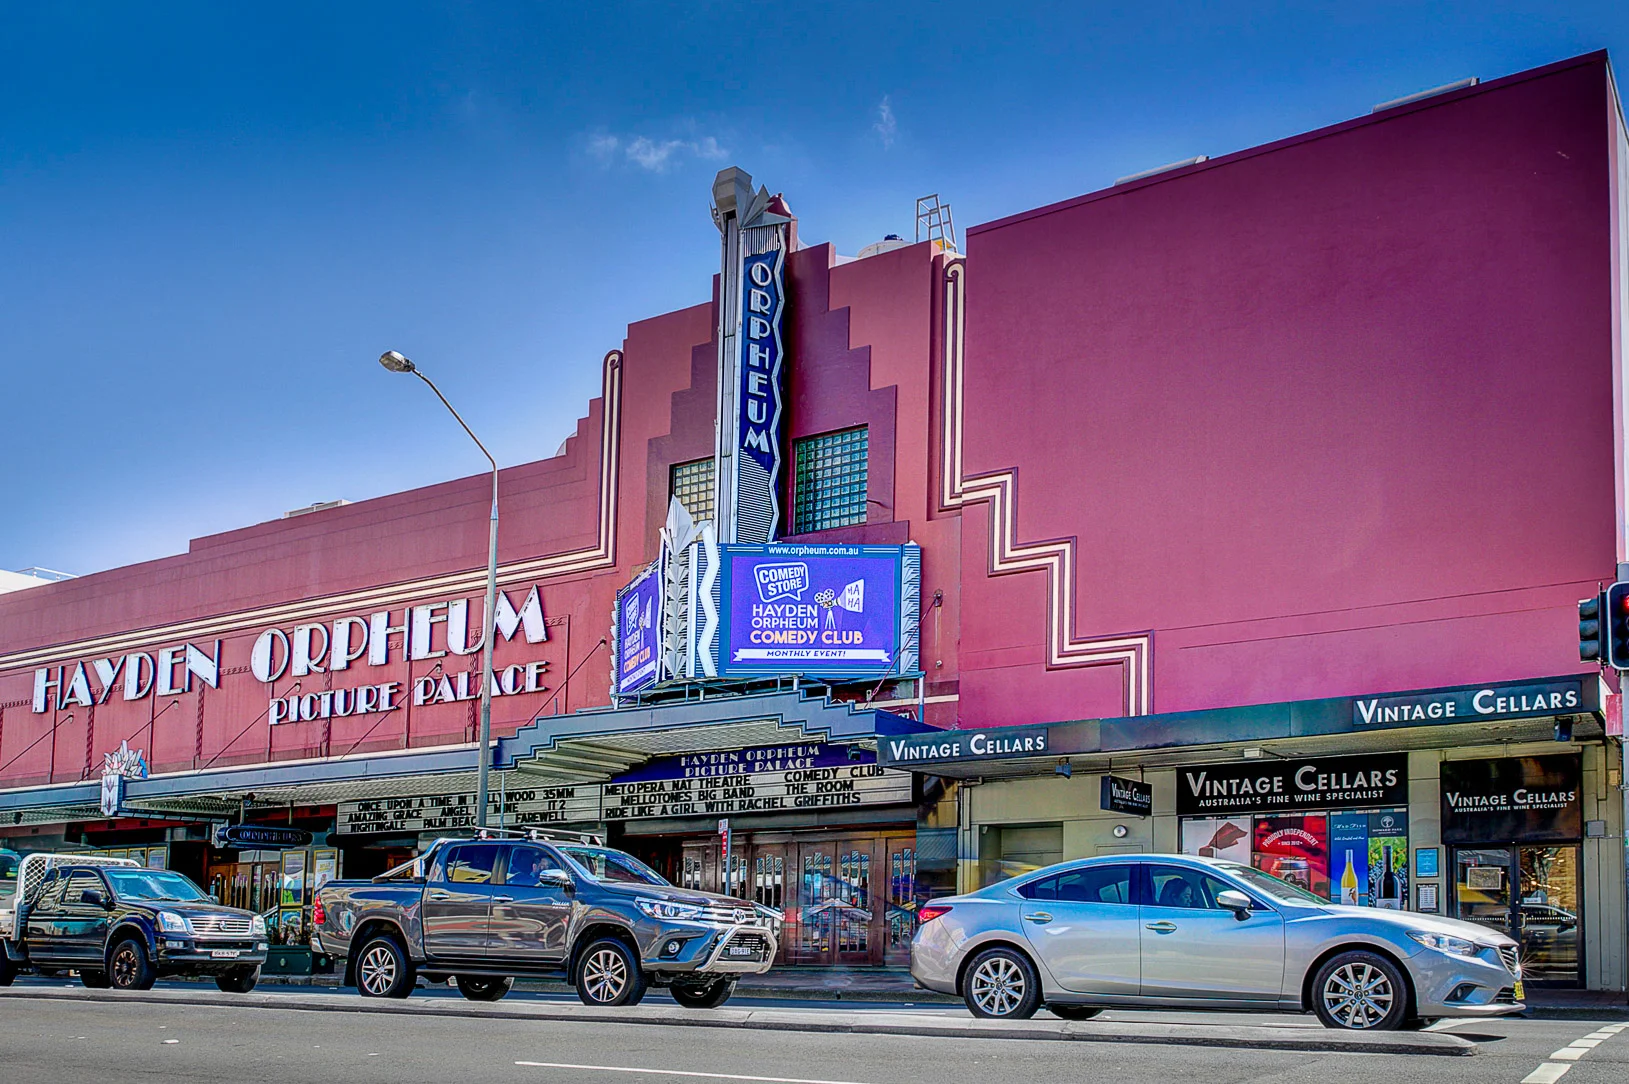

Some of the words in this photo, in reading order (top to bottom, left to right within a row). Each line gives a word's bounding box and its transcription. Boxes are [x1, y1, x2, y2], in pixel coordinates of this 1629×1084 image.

[744, 262, 772, 453] ORPHEUM
[768, 546, 859, 556] www.orpheum.com.au
[759, 566, 805, 584] COMEDY
[768, 579, 802, 596] STORE
[752, 604, 818, 617] HAYDEN
[751, 617, 819, 629] ORPHEUM
[750, 630, 818, 644] COMEDY
[821, 630, 864, 644] CLUB
[32, 638, 221, 714] HAYDEN
[250, 584, 548, 683] ORPHEUM
[269, 681, 400, 726] PICTURE
[413, 660, 549, 707] PALACE
[1356, 698, 1456, 725] VINTAGE
[1472, 689, 1578, 714] CELLARS
[681, 752, 739, 767] HAYDEN
[746, 745, 820, 760] ORPHEUM
[890, 740, 960, 761] VINTAGE
[970, 734, 1045, 755] CELLARS
[671, 779, 694, 791] NAT
[698, 774, 752, 789] THEATRE
[784, 767, 840, 782] COMEDY
[850, 765, 884, 778] CLUB
[684, 764, 747, 778] PICTURE
[754, 757, 815, 771] PALACE
[1186, 771, 1283, 797] VINTAGE
[1294, 765, 1397, 791] CELLARS
[358, 801, 381, 811] ONCE
[386, 799, 413, 810] UPON
[418, 797, 425, 808] A
[430, 796, 453, 807] TIME
[457, 795, 467, 805] IN
[543, 788, 575, 799] 35MM
[621, 791, 692, 806] MELLOTONES
[698, 789, 717, 801] BIG
[723, 787, 755, 799] BAND
[784, 783, 809, 795] THE
[816, 780, 854, 793] ROOM
[1111, 782, 1132, 800] VINTAGE
[1132, 788, 1151, 804] CELLARS
[1198, 796, 1262, 807] AUSTRALIA'S
[1267, 795, 1290, 804] FINE
[1294, 793, 1321, 802] WINE
[1325, 790, 1384, 801] SPECIALIST
[1446, 792, 1507, 807] VINTAGE
[1513, 789, 1576, 804] CELLARS
[347, 811, 388, 823] AMAZING
[393, 809, 423, 820] GRACE
[440, 806, 471, 817] ANGEL
[548, 800, 557, 810] IT
[559, 800, 566, 810] 2
[605, 807, 629, 818] RIDE
[632, 805, 655, 817] LIKE
[671, 803, 698, 814] GIRL
[705, 800, 734, 812] WITH
[739, 797, 787, 811] RACHEL
[794, 792, 861, 807] GRIFFITHS
[350, 820, 406, 833] NIGHTINGALE
[423, 818, 447, 828] PALM
[452, 816, 477, 827] BEAC
[515, 811, 568, 823] FAREWELL
[1262, 829, 1284, 848] PROUDLY
[1284, 828, 1319, 847] INDEPENDENT
